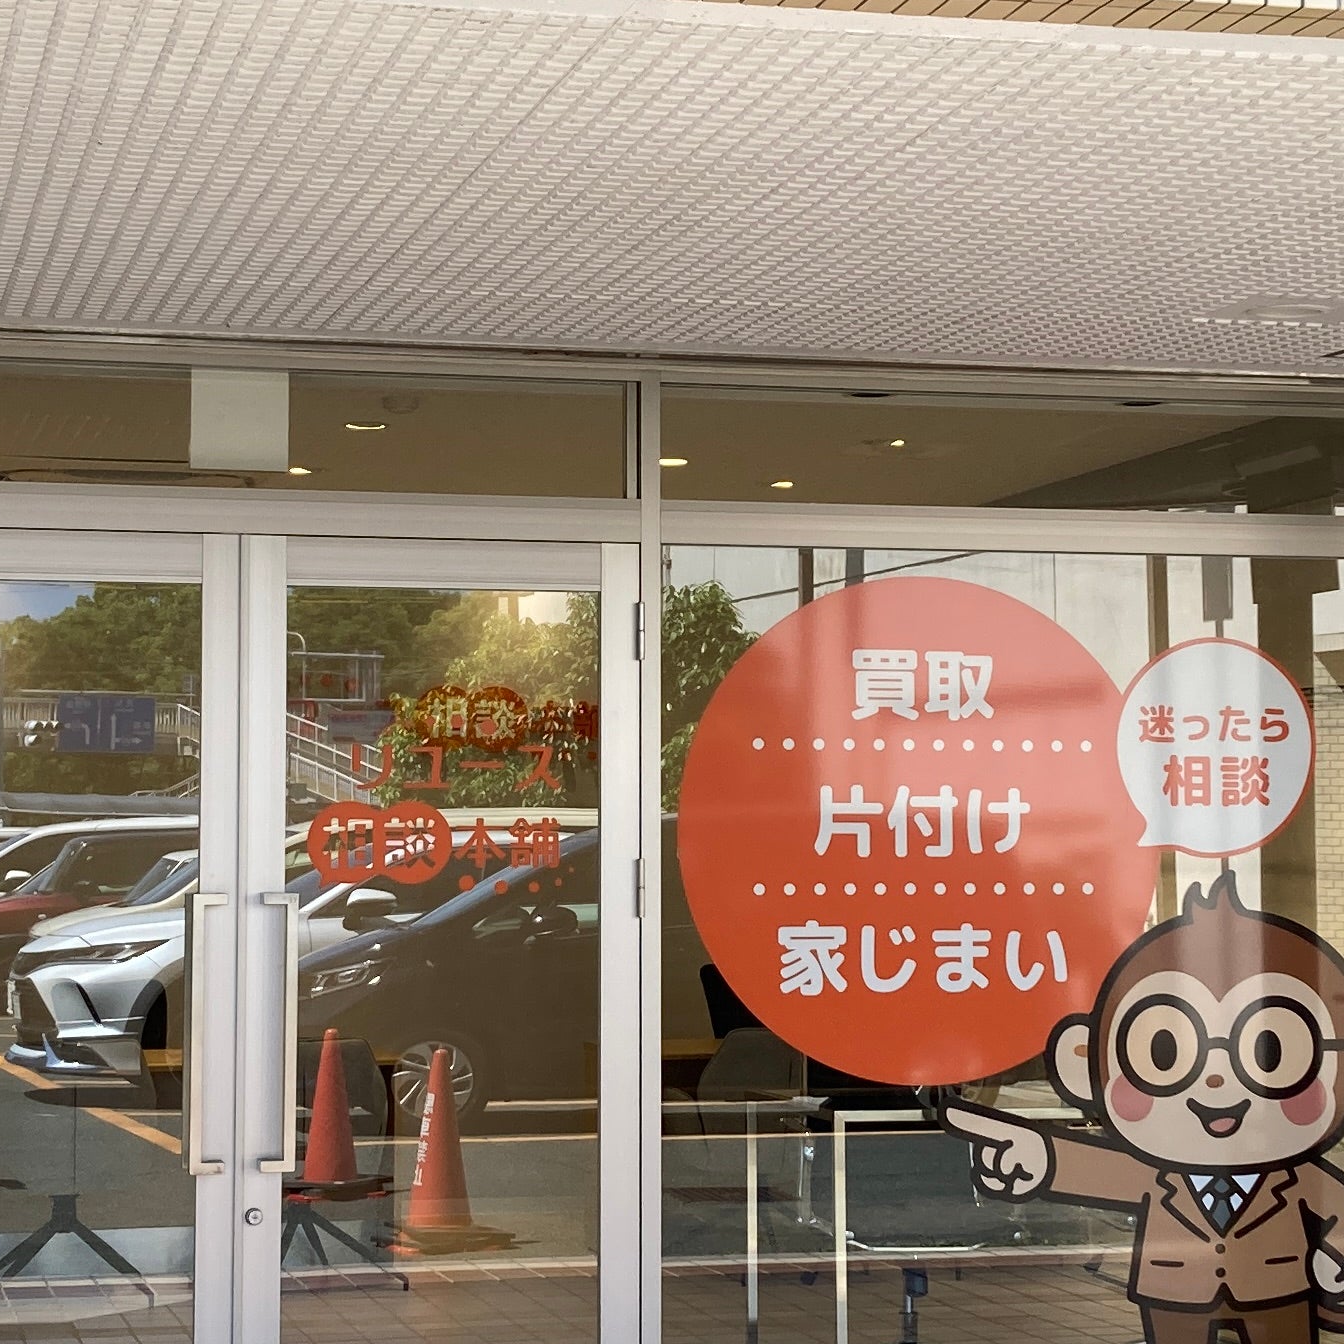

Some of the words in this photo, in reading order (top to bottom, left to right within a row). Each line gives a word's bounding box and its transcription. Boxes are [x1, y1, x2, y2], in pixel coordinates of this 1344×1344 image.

[851, 649, 995, 721] 買取
[1138, 704, 1290, 743] 迷ったら
[351, 743, 561, 790] リユース
[1162, 754, 1271, 807] 相談
[321, 816, 561, 870] 相談本舗
[814, 784, 1031, 858] 片付け
[777, 919, 1068, 997] 家じまい
